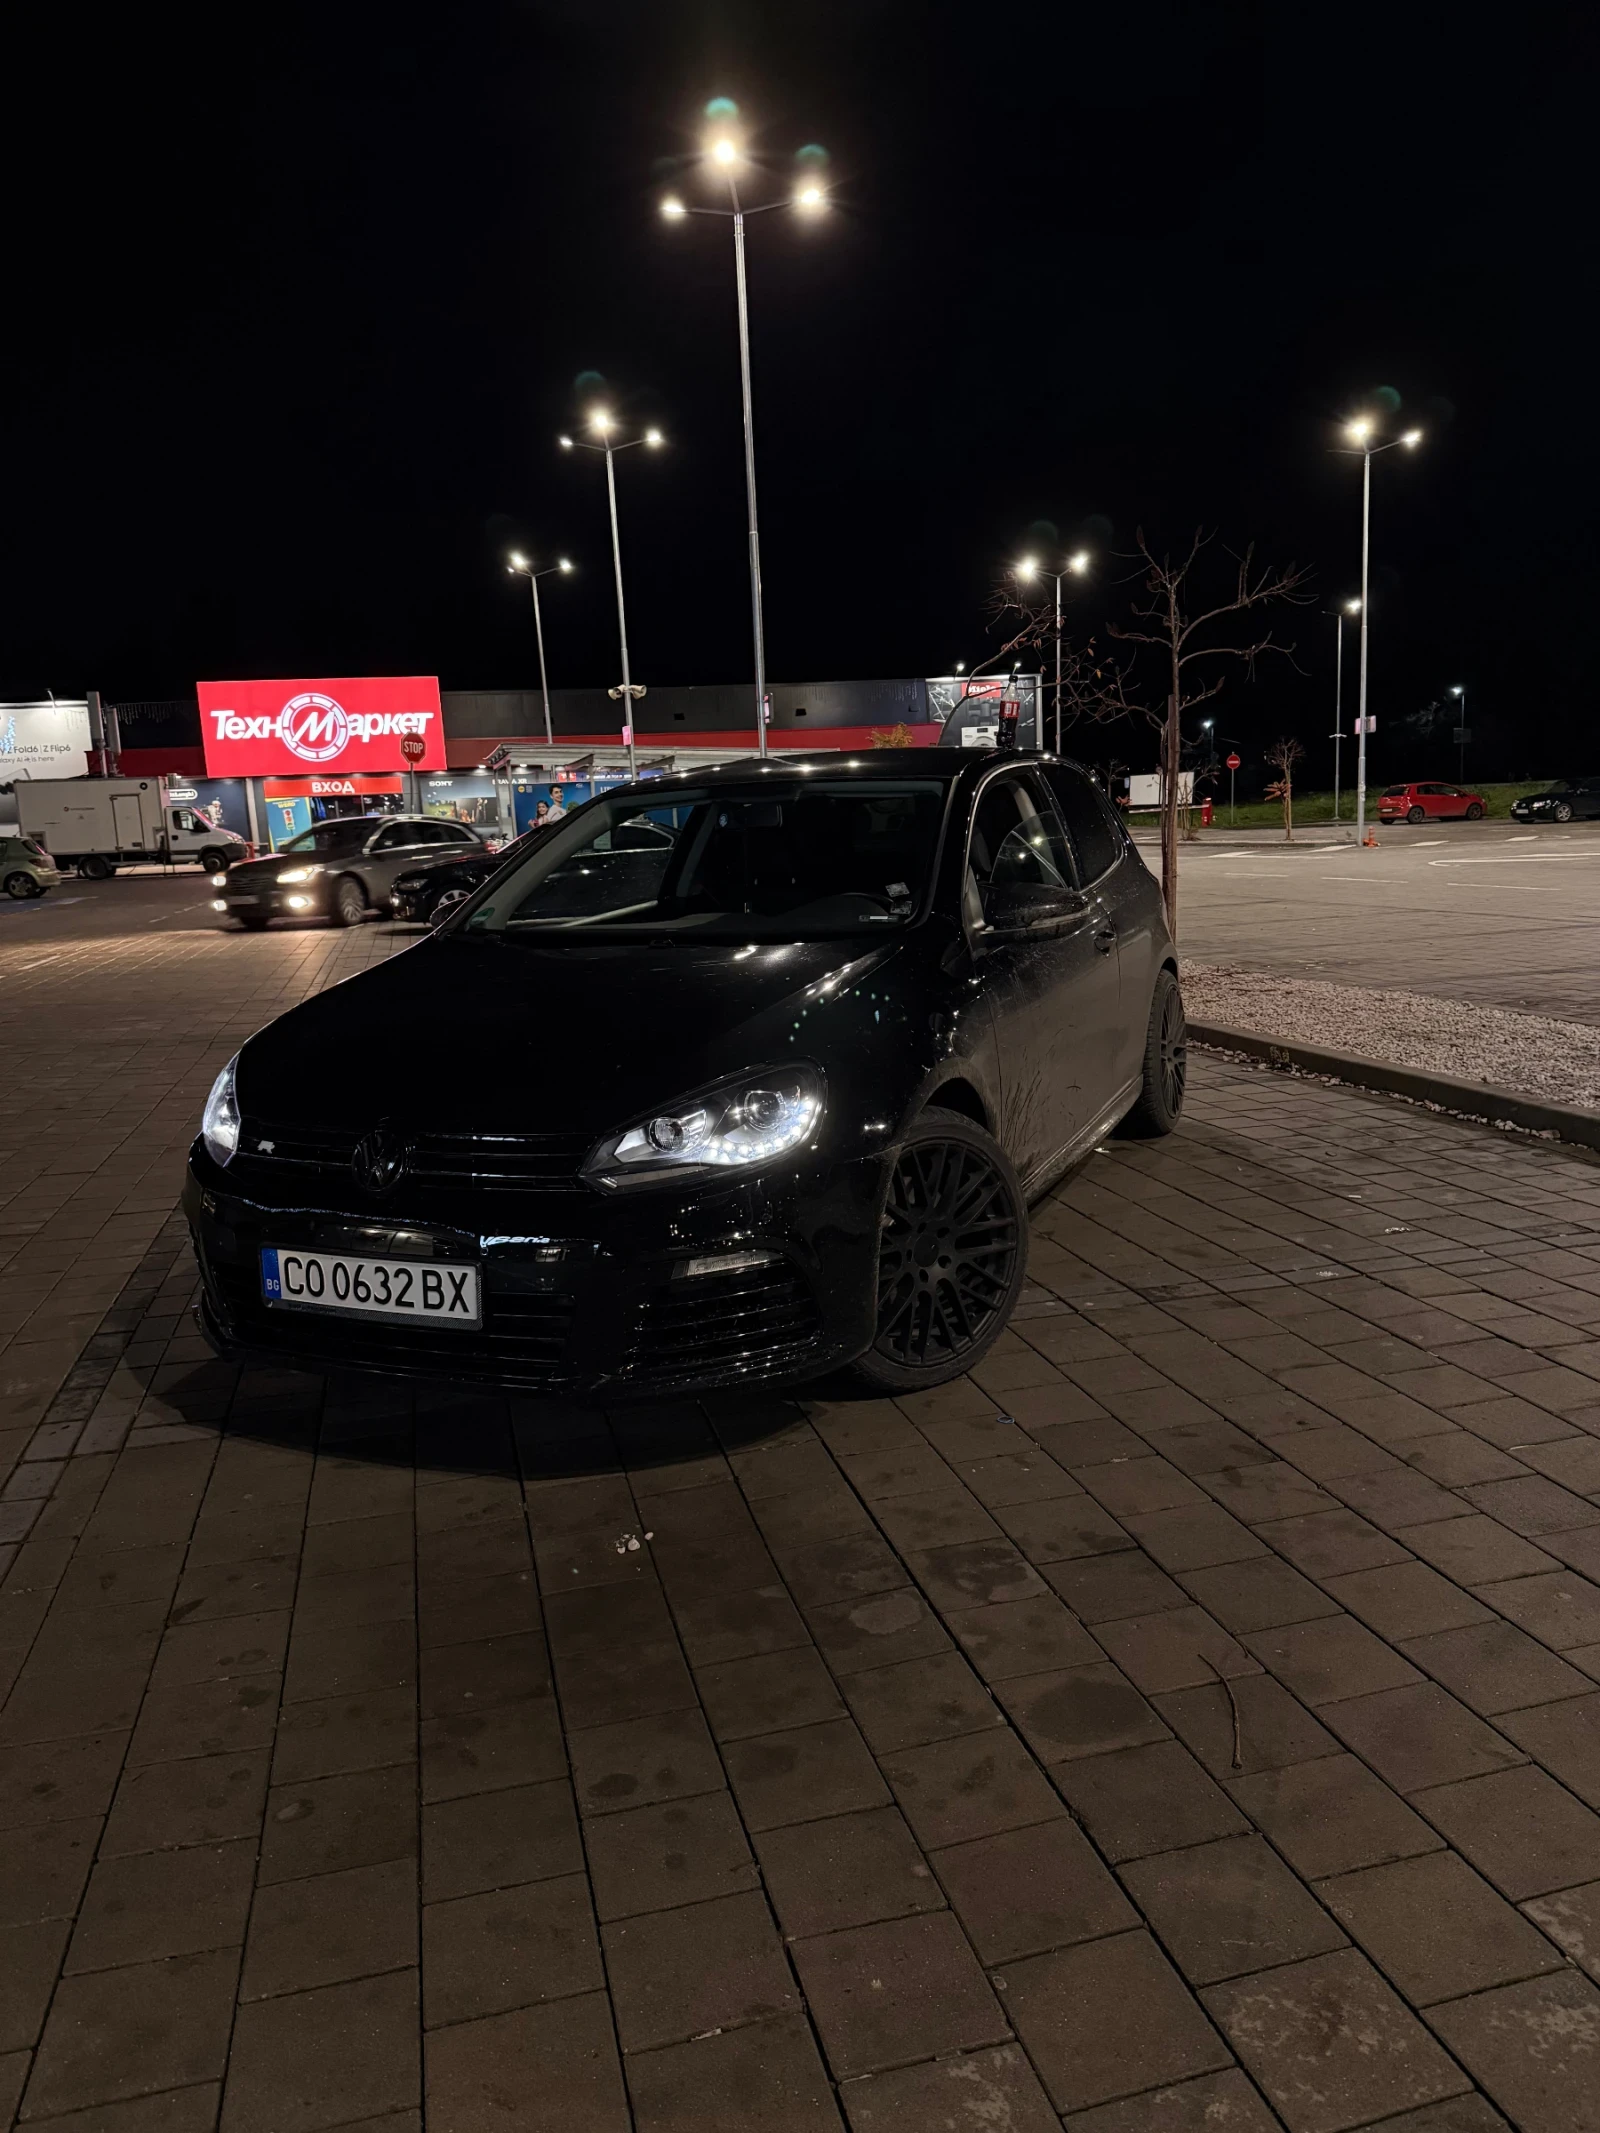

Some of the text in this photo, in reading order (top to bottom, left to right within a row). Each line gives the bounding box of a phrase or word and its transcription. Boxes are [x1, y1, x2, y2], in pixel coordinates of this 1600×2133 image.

[13, 745, 39, 754] Fold6
[43, 745, 49, 753] Z
[50, 744, 71, 754] Flip6
[403, 740, 424, 754] STOP
[311, 781, 355, 794] ВХОД
[266, 1278, 280, 1291] BG
[283, 1256, 470, 1313] CO 0632 BX
